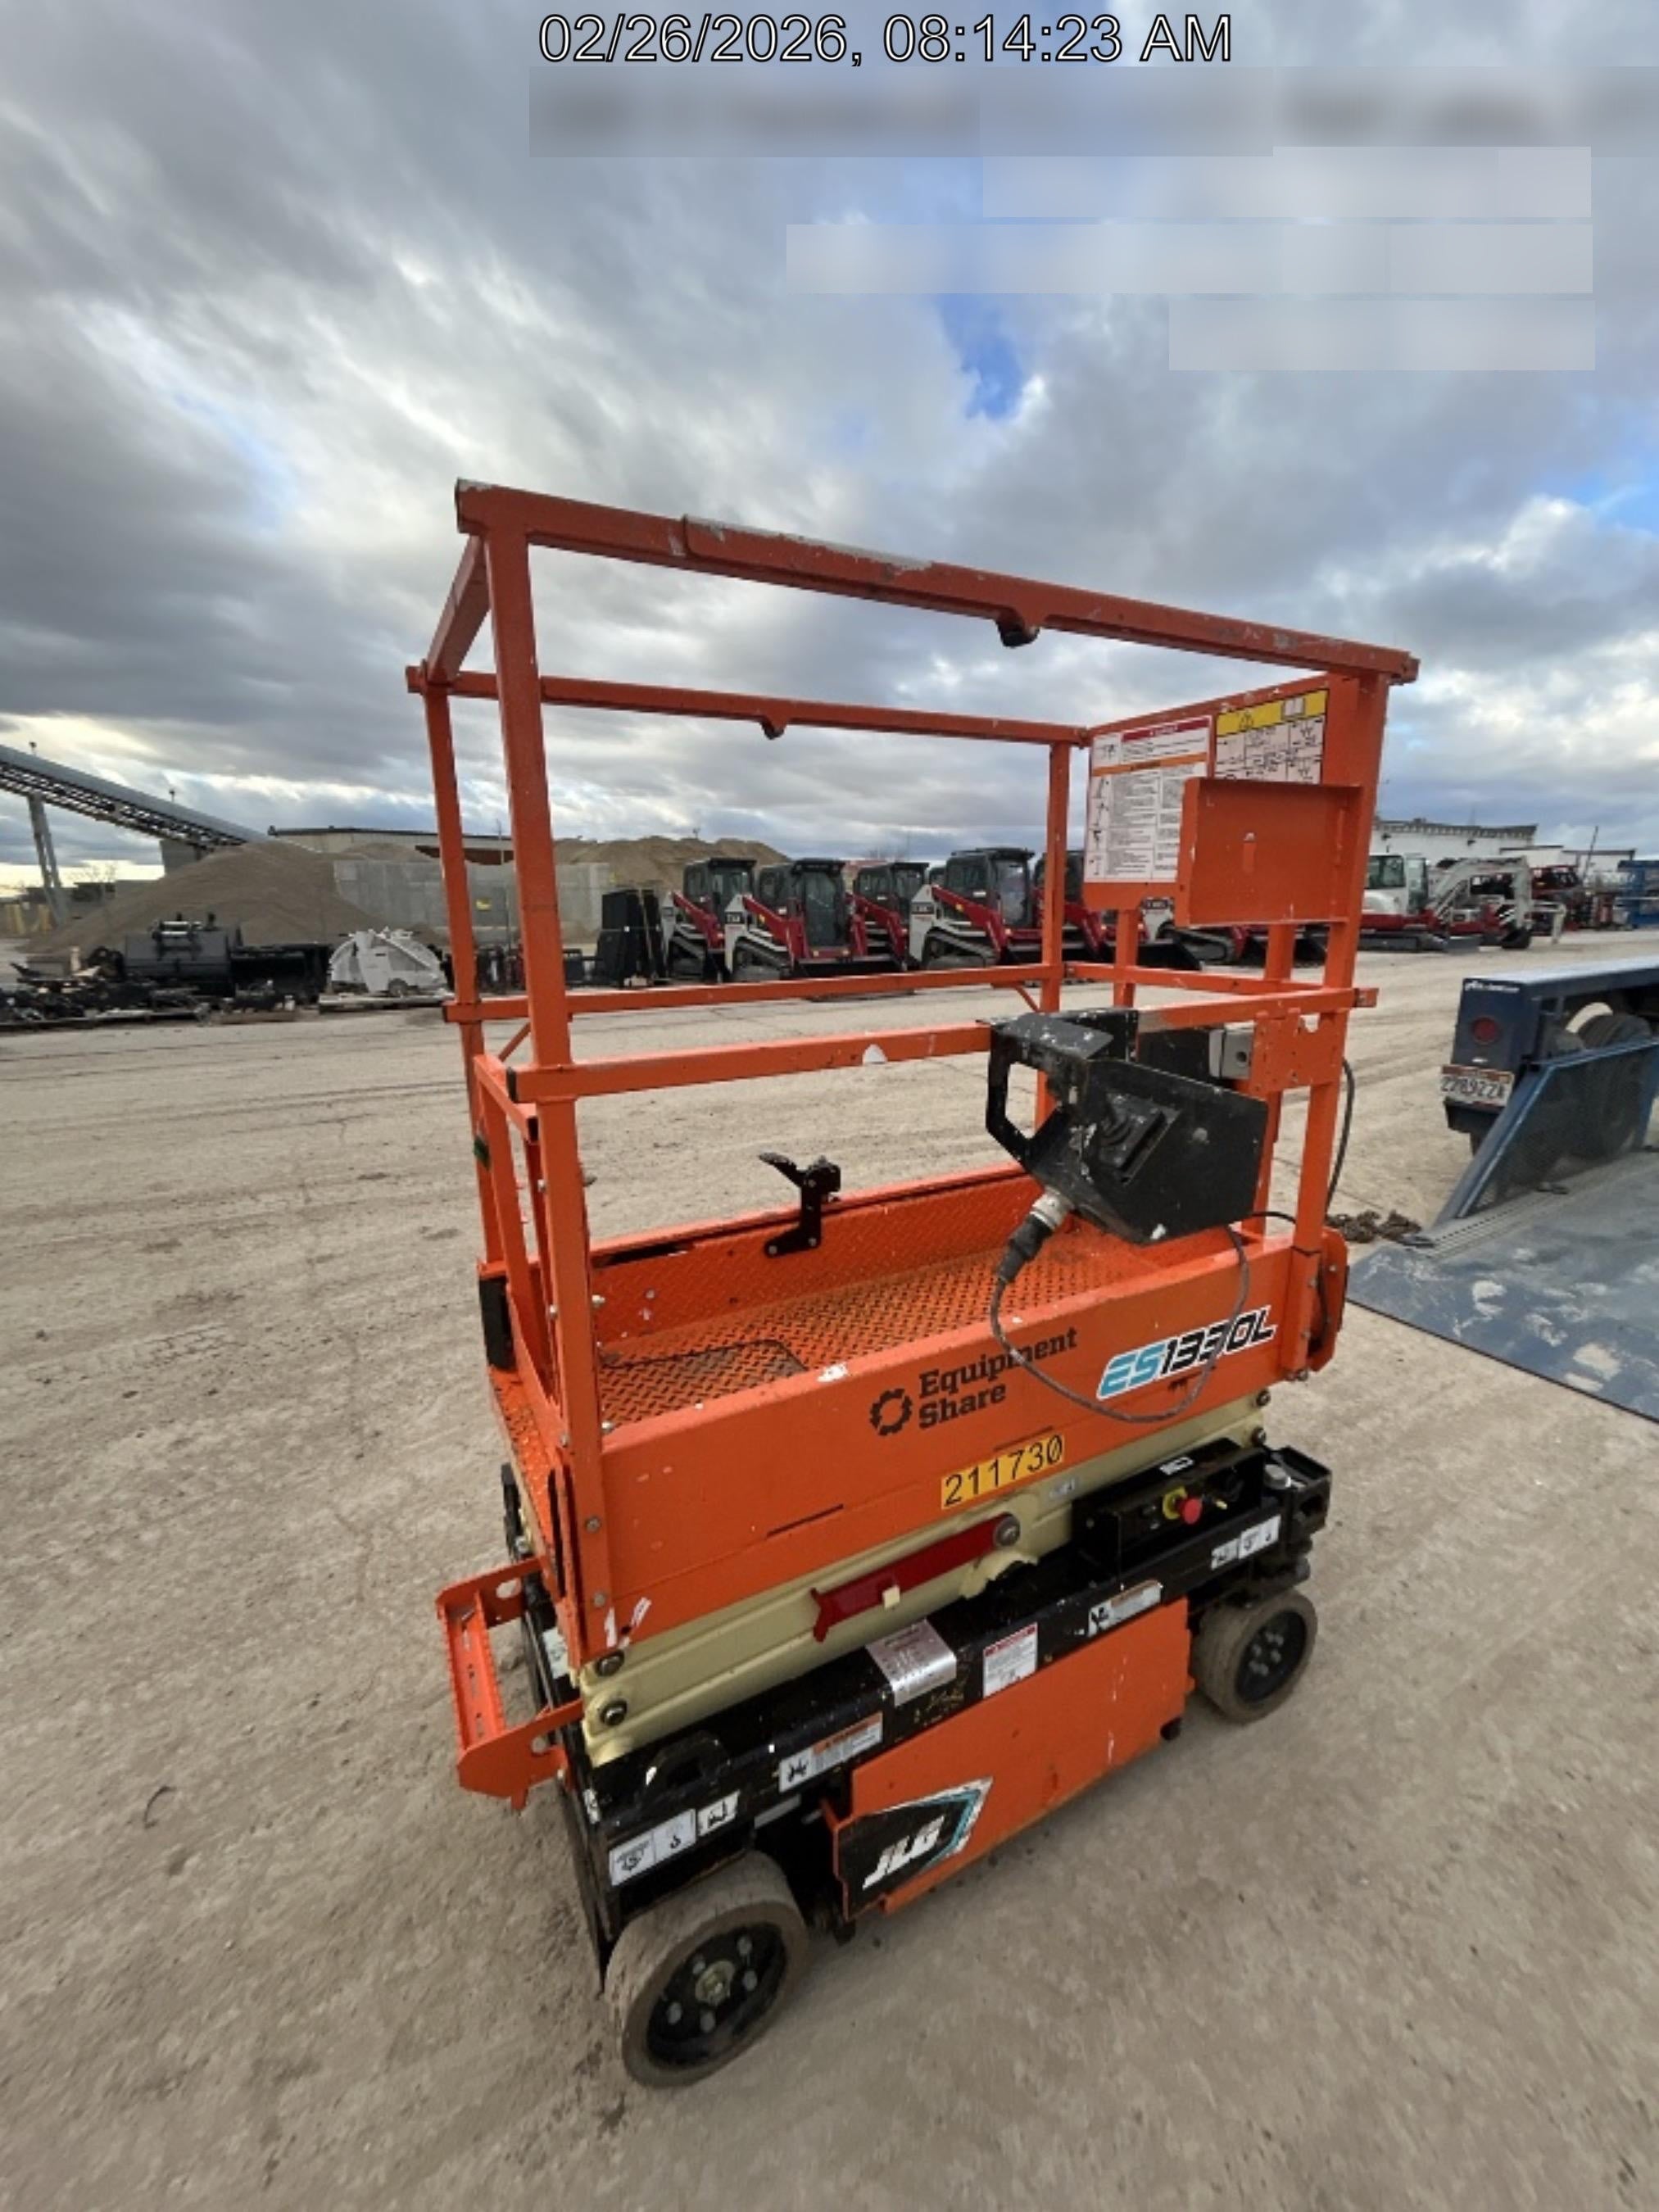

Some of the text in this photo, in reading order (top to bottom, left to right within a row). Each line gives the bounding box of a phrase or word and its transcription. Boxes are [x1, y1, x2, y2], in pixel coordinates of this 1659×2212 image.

[919, 1327, 1077, 1398] Equipment
[1097, 1305, 1278, 1400] ES1330L
[919, 1383, 1006, 1430] Share
[945, 1435, 1063, 1506] 211730
